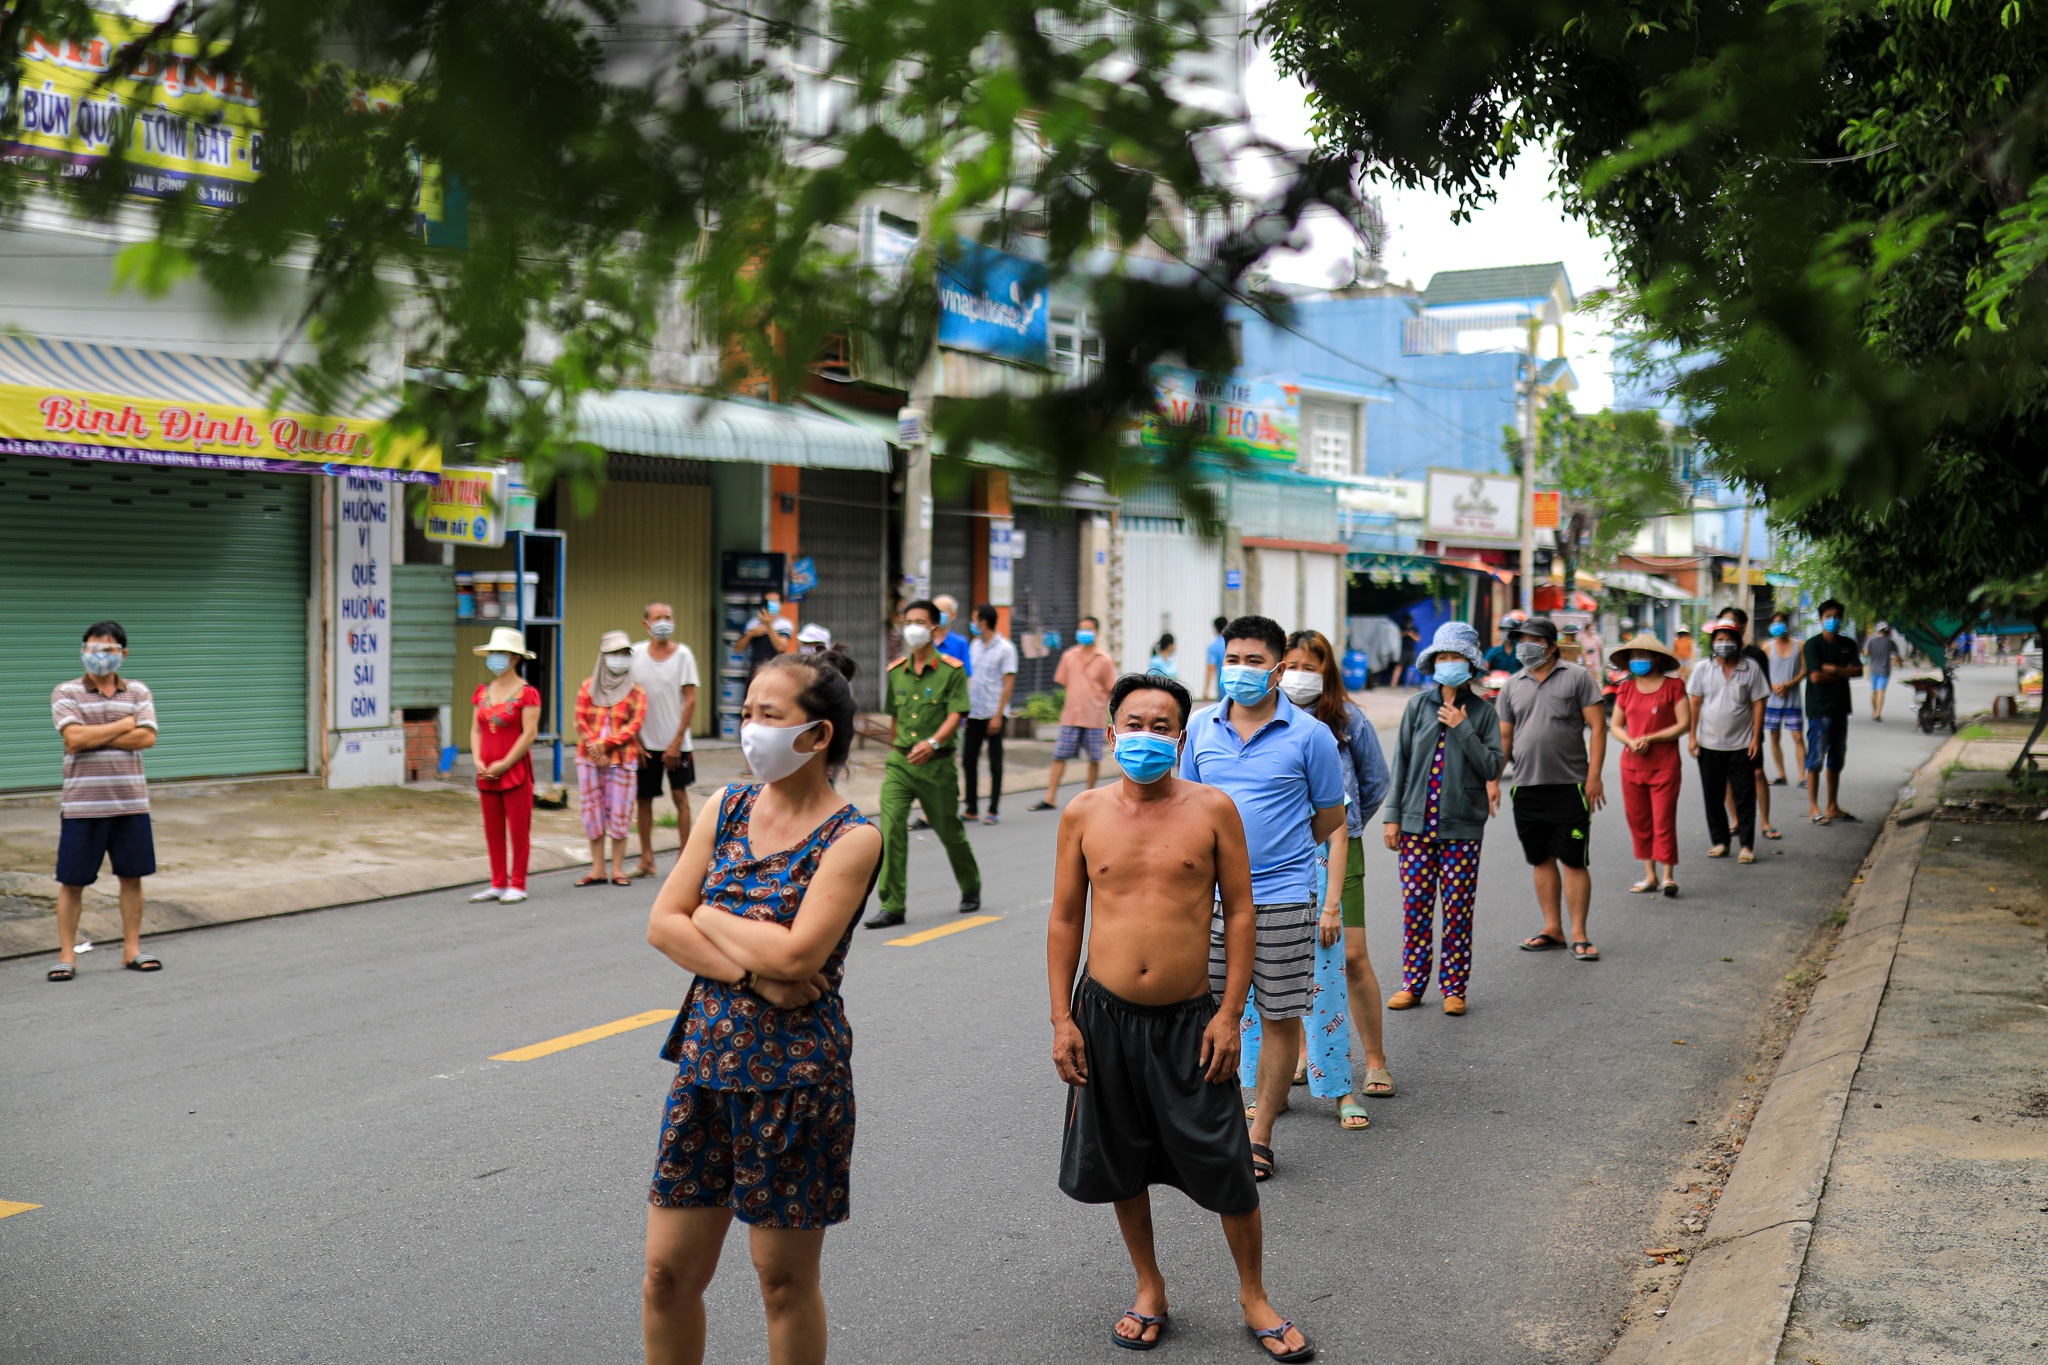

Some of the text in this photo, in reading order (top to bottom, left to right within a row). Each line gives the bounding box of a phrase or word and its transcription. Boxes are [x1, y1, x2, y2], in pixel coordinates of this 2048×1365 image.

[23, 80, 72, 138] BÚN
[141, 102, 190, 161] TÔM
[38, 394, 374, 457] Bình Định Quán
[1171, 399, 1274, 442] MAI HOA
[429, 516, 448, 535] TÔM
[351, 559, 377, 588] QUÊ
[353, 659, 374, 687] SÀI
[351, 692, 376, 718] GÒN
